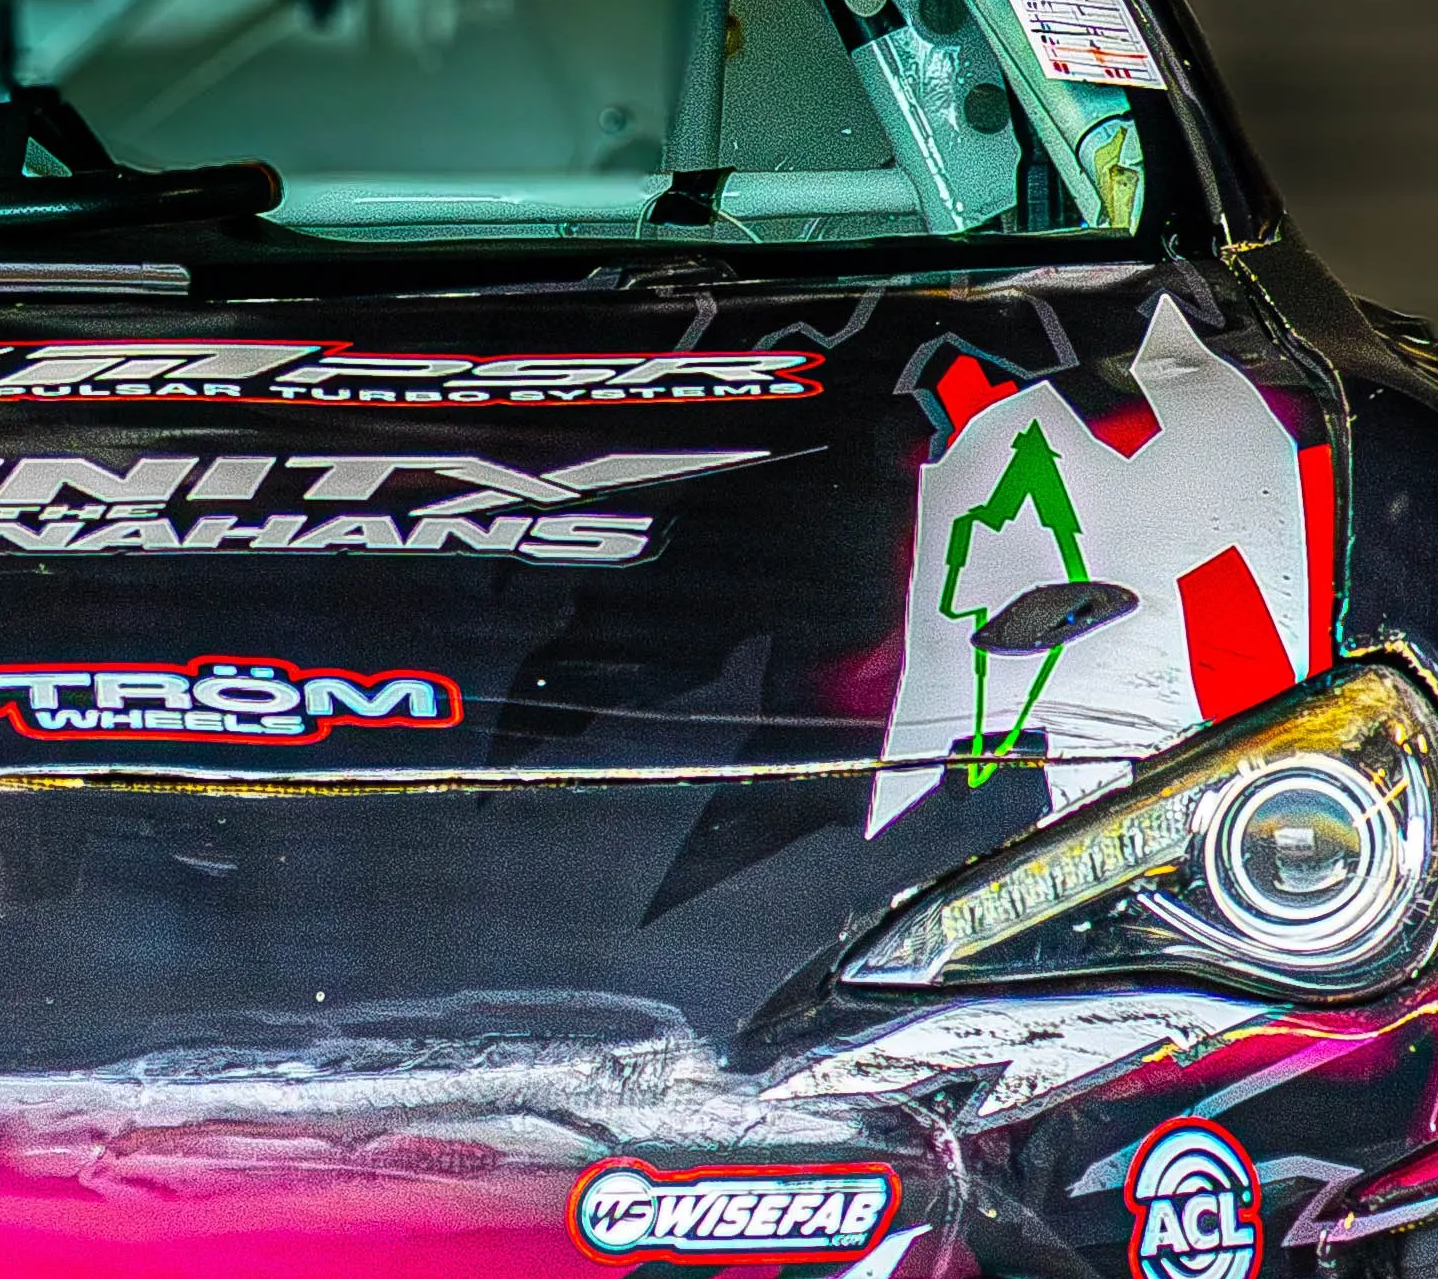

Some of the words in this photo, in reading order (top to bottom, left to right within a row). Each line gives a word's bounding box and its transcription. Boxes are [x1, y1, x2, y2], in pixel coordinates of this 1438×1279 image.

[270, 384, 490, 402] TURBO
[509, 382, 806, 402] SYSTEMS
[35, 708, 306, 734] WHEELS
[653, 1190, 886, 1238] WISEFAB
[1139, 1193, 1255, 1257] ACL
